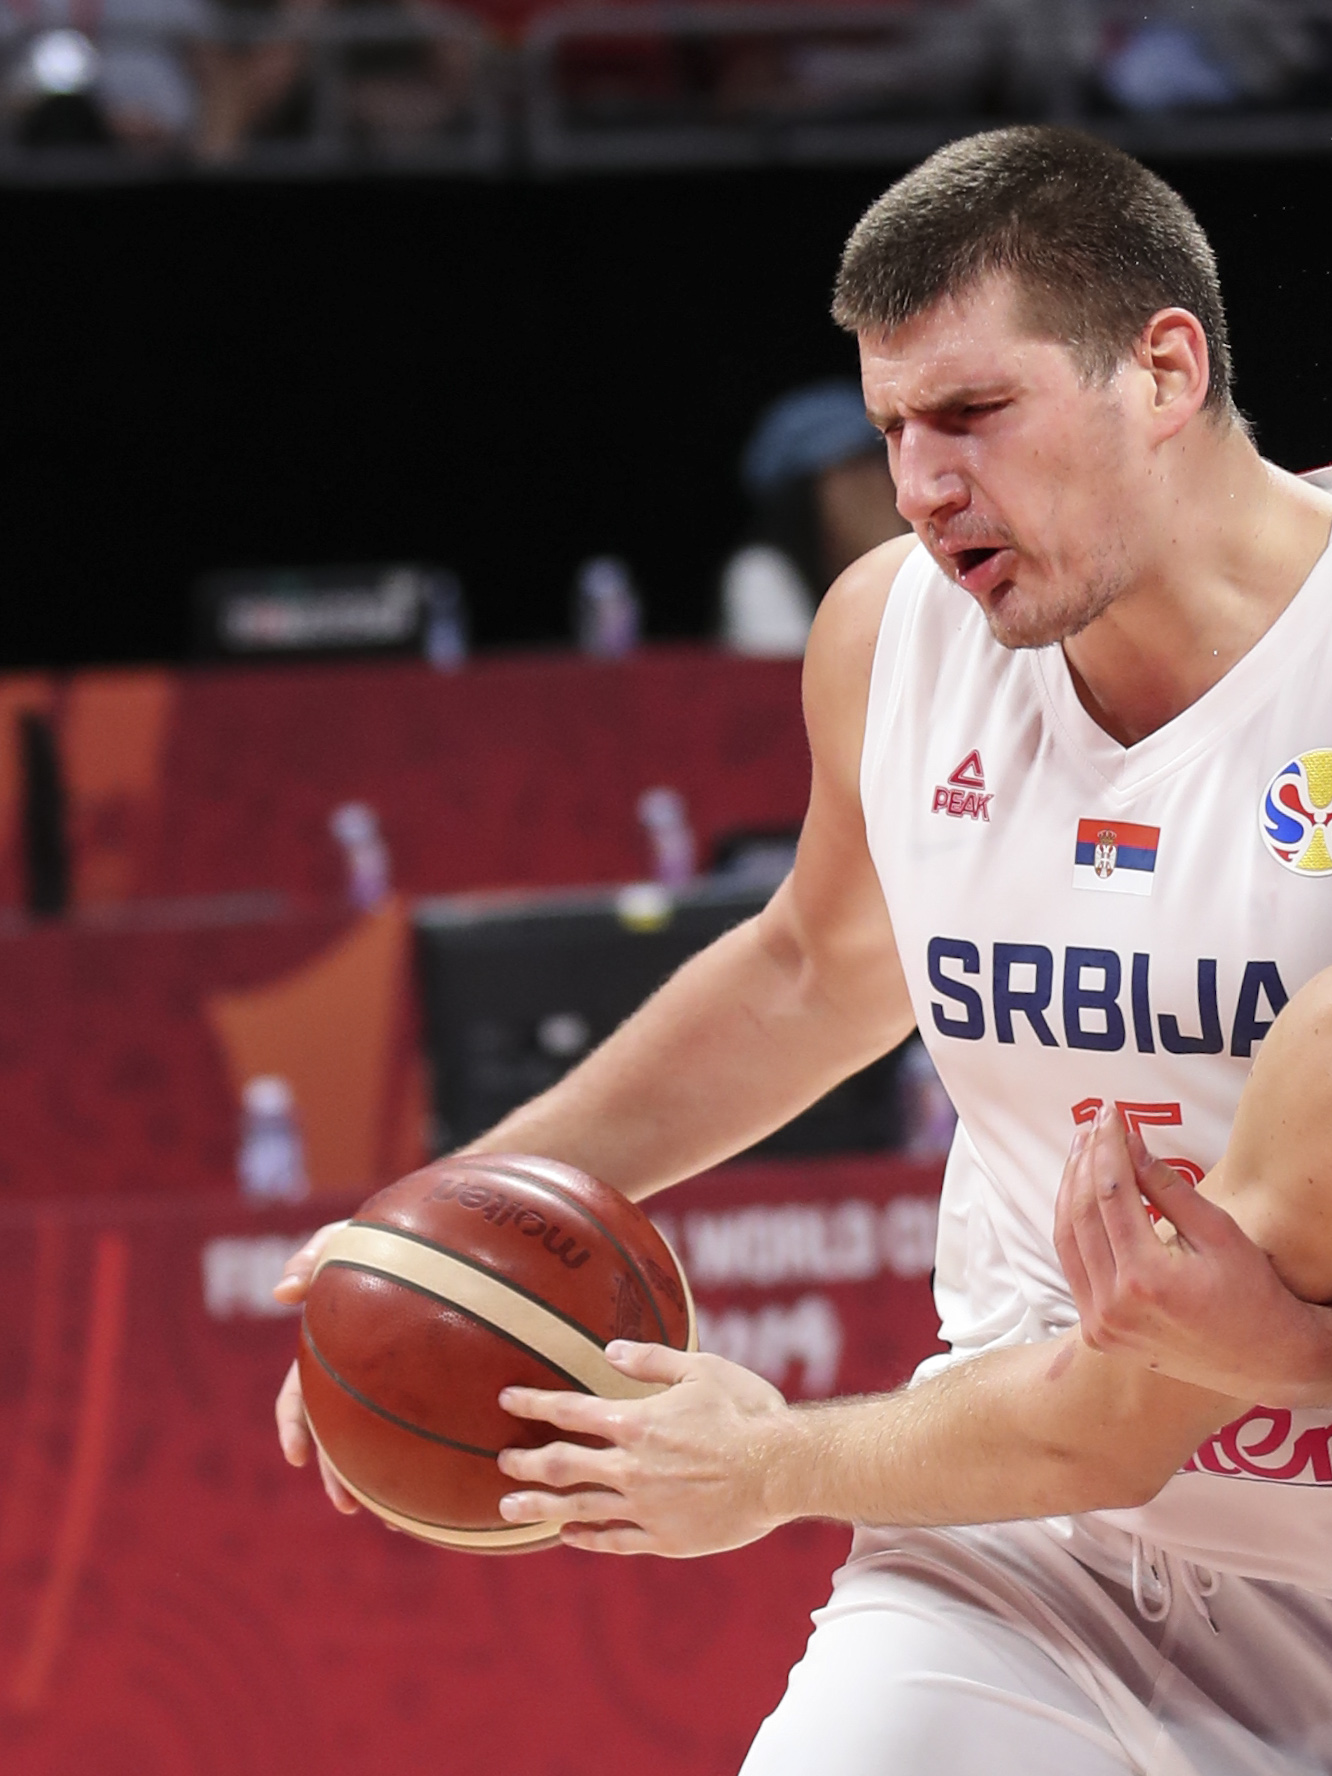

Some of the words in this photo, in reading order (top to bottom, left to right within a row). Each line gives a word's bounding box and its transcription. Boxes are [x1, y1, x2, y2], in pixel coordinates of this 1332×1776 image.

[931, 785, 996, 823] PEAK
[926, 936, 1291, 1058] SRBIJA
[432, 1180, 592, 1270] molten
